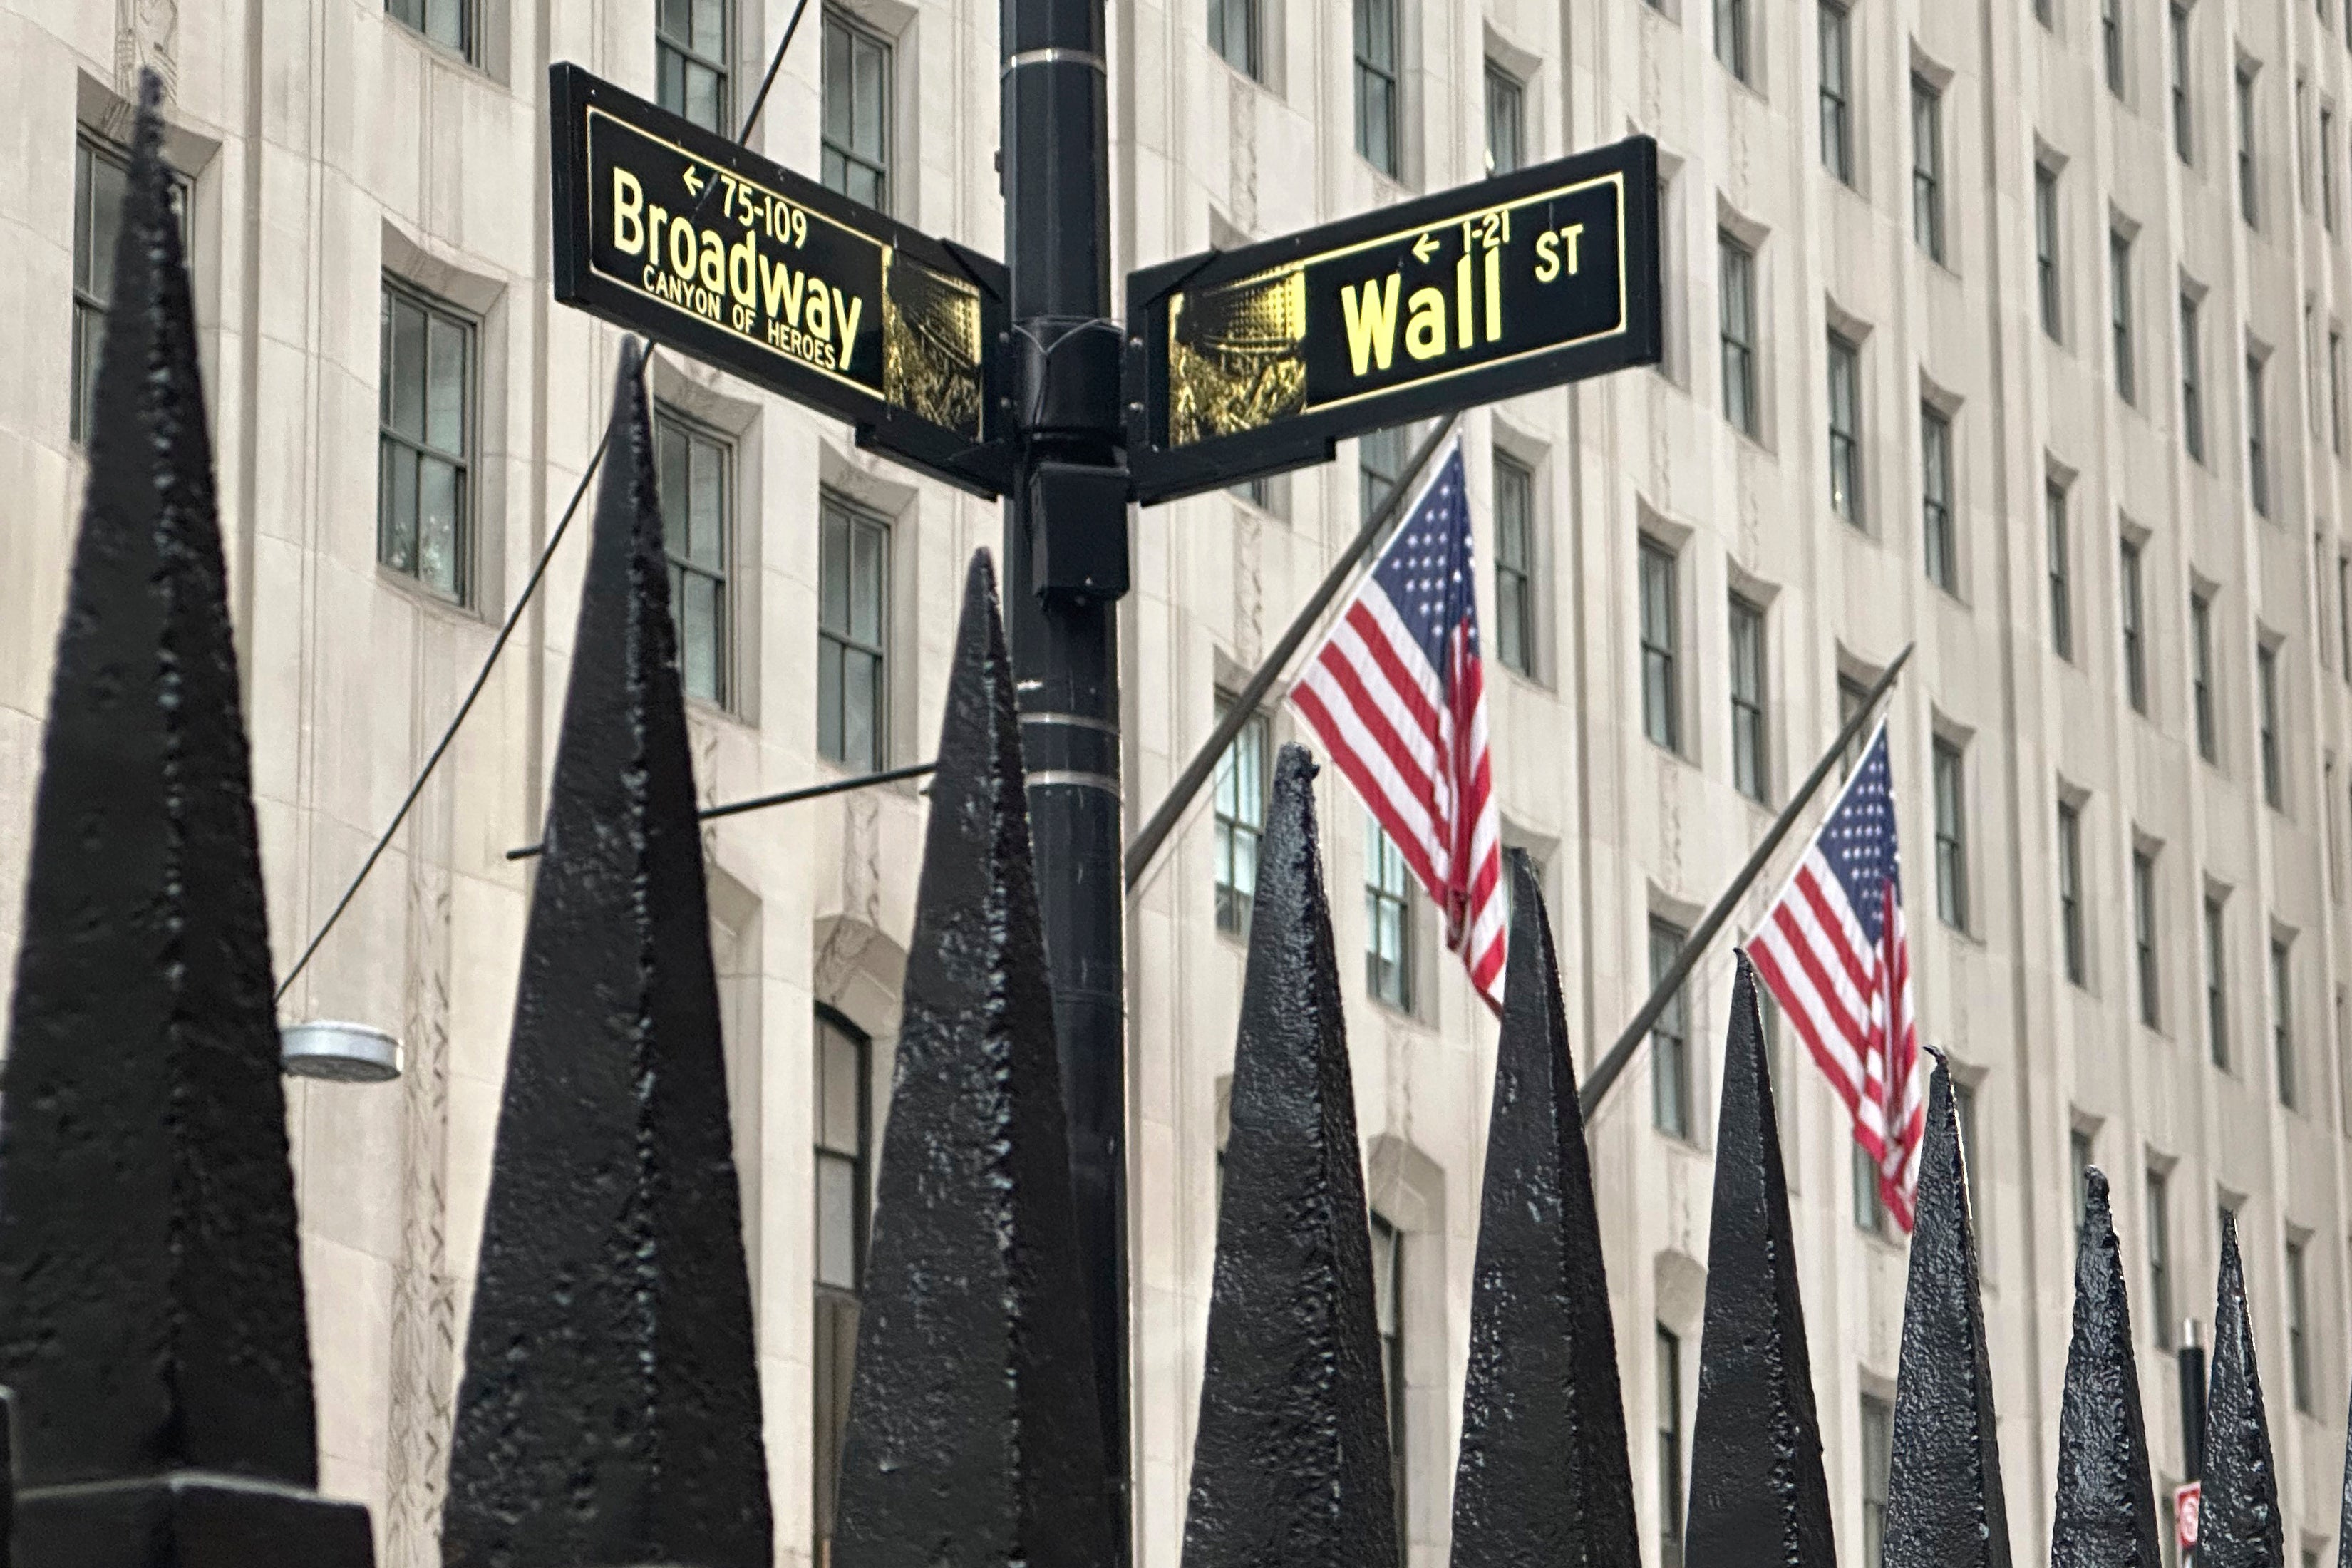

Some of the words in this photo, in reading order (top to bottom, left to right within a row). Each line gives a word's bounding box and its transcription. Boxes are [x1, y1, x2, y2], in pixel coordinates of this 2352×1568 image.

[720, 175, 807, 249] 75-109
[1463, 210, 1510, 253] 1-21
[613, 167, 863, 371] Broadway
[644, 264, 721, 321] CANYON
[732, 305, 756, 334] OF
[768, 319, 836, 371] HEROES
[1341, 247, 1501, 376] Wall
[1535, 225, 1584, 282] ST
